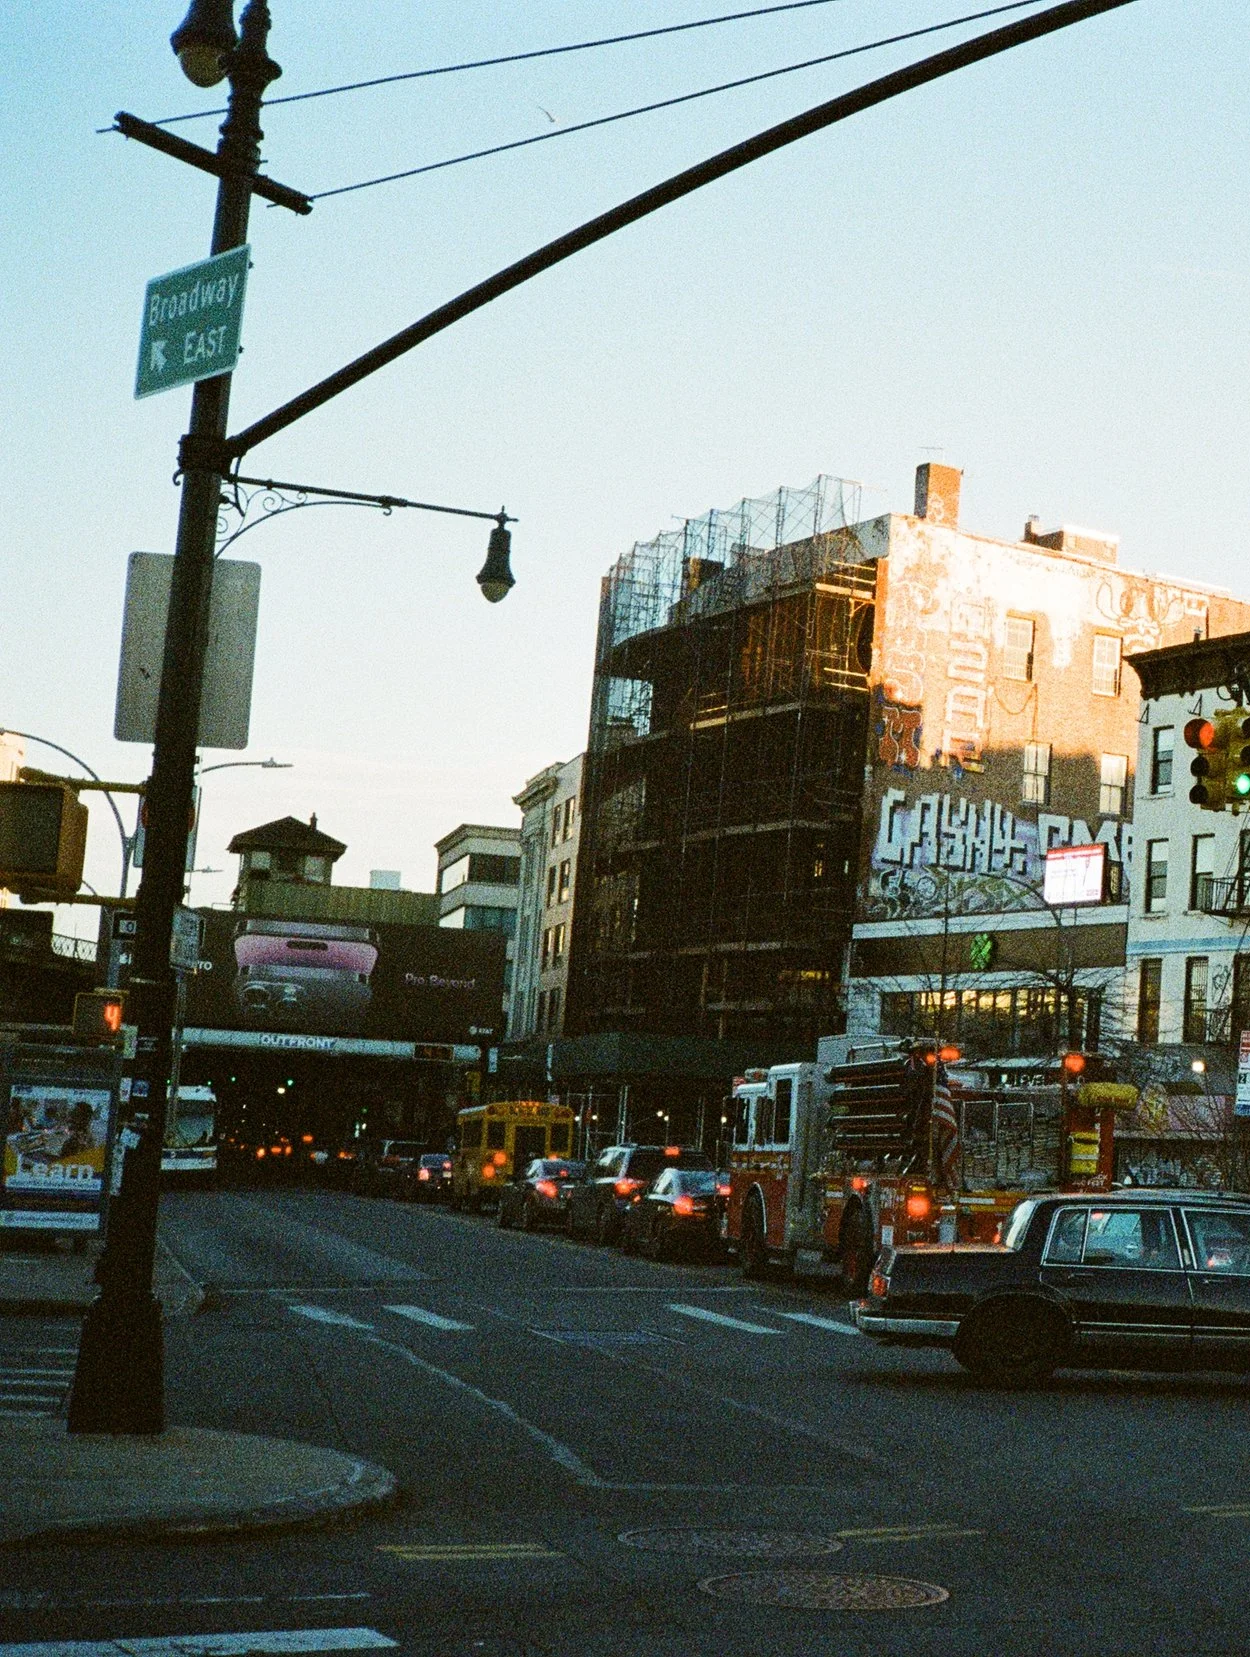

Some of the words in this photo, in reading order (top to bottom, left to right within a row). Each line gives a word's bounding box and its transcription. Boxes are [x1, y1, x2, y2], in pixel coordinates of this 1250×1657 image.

[149, 273, 240, 326] Broadway
[183, 325, 228, 365] EAST
[17, 1154, 96, 1180] Learn
